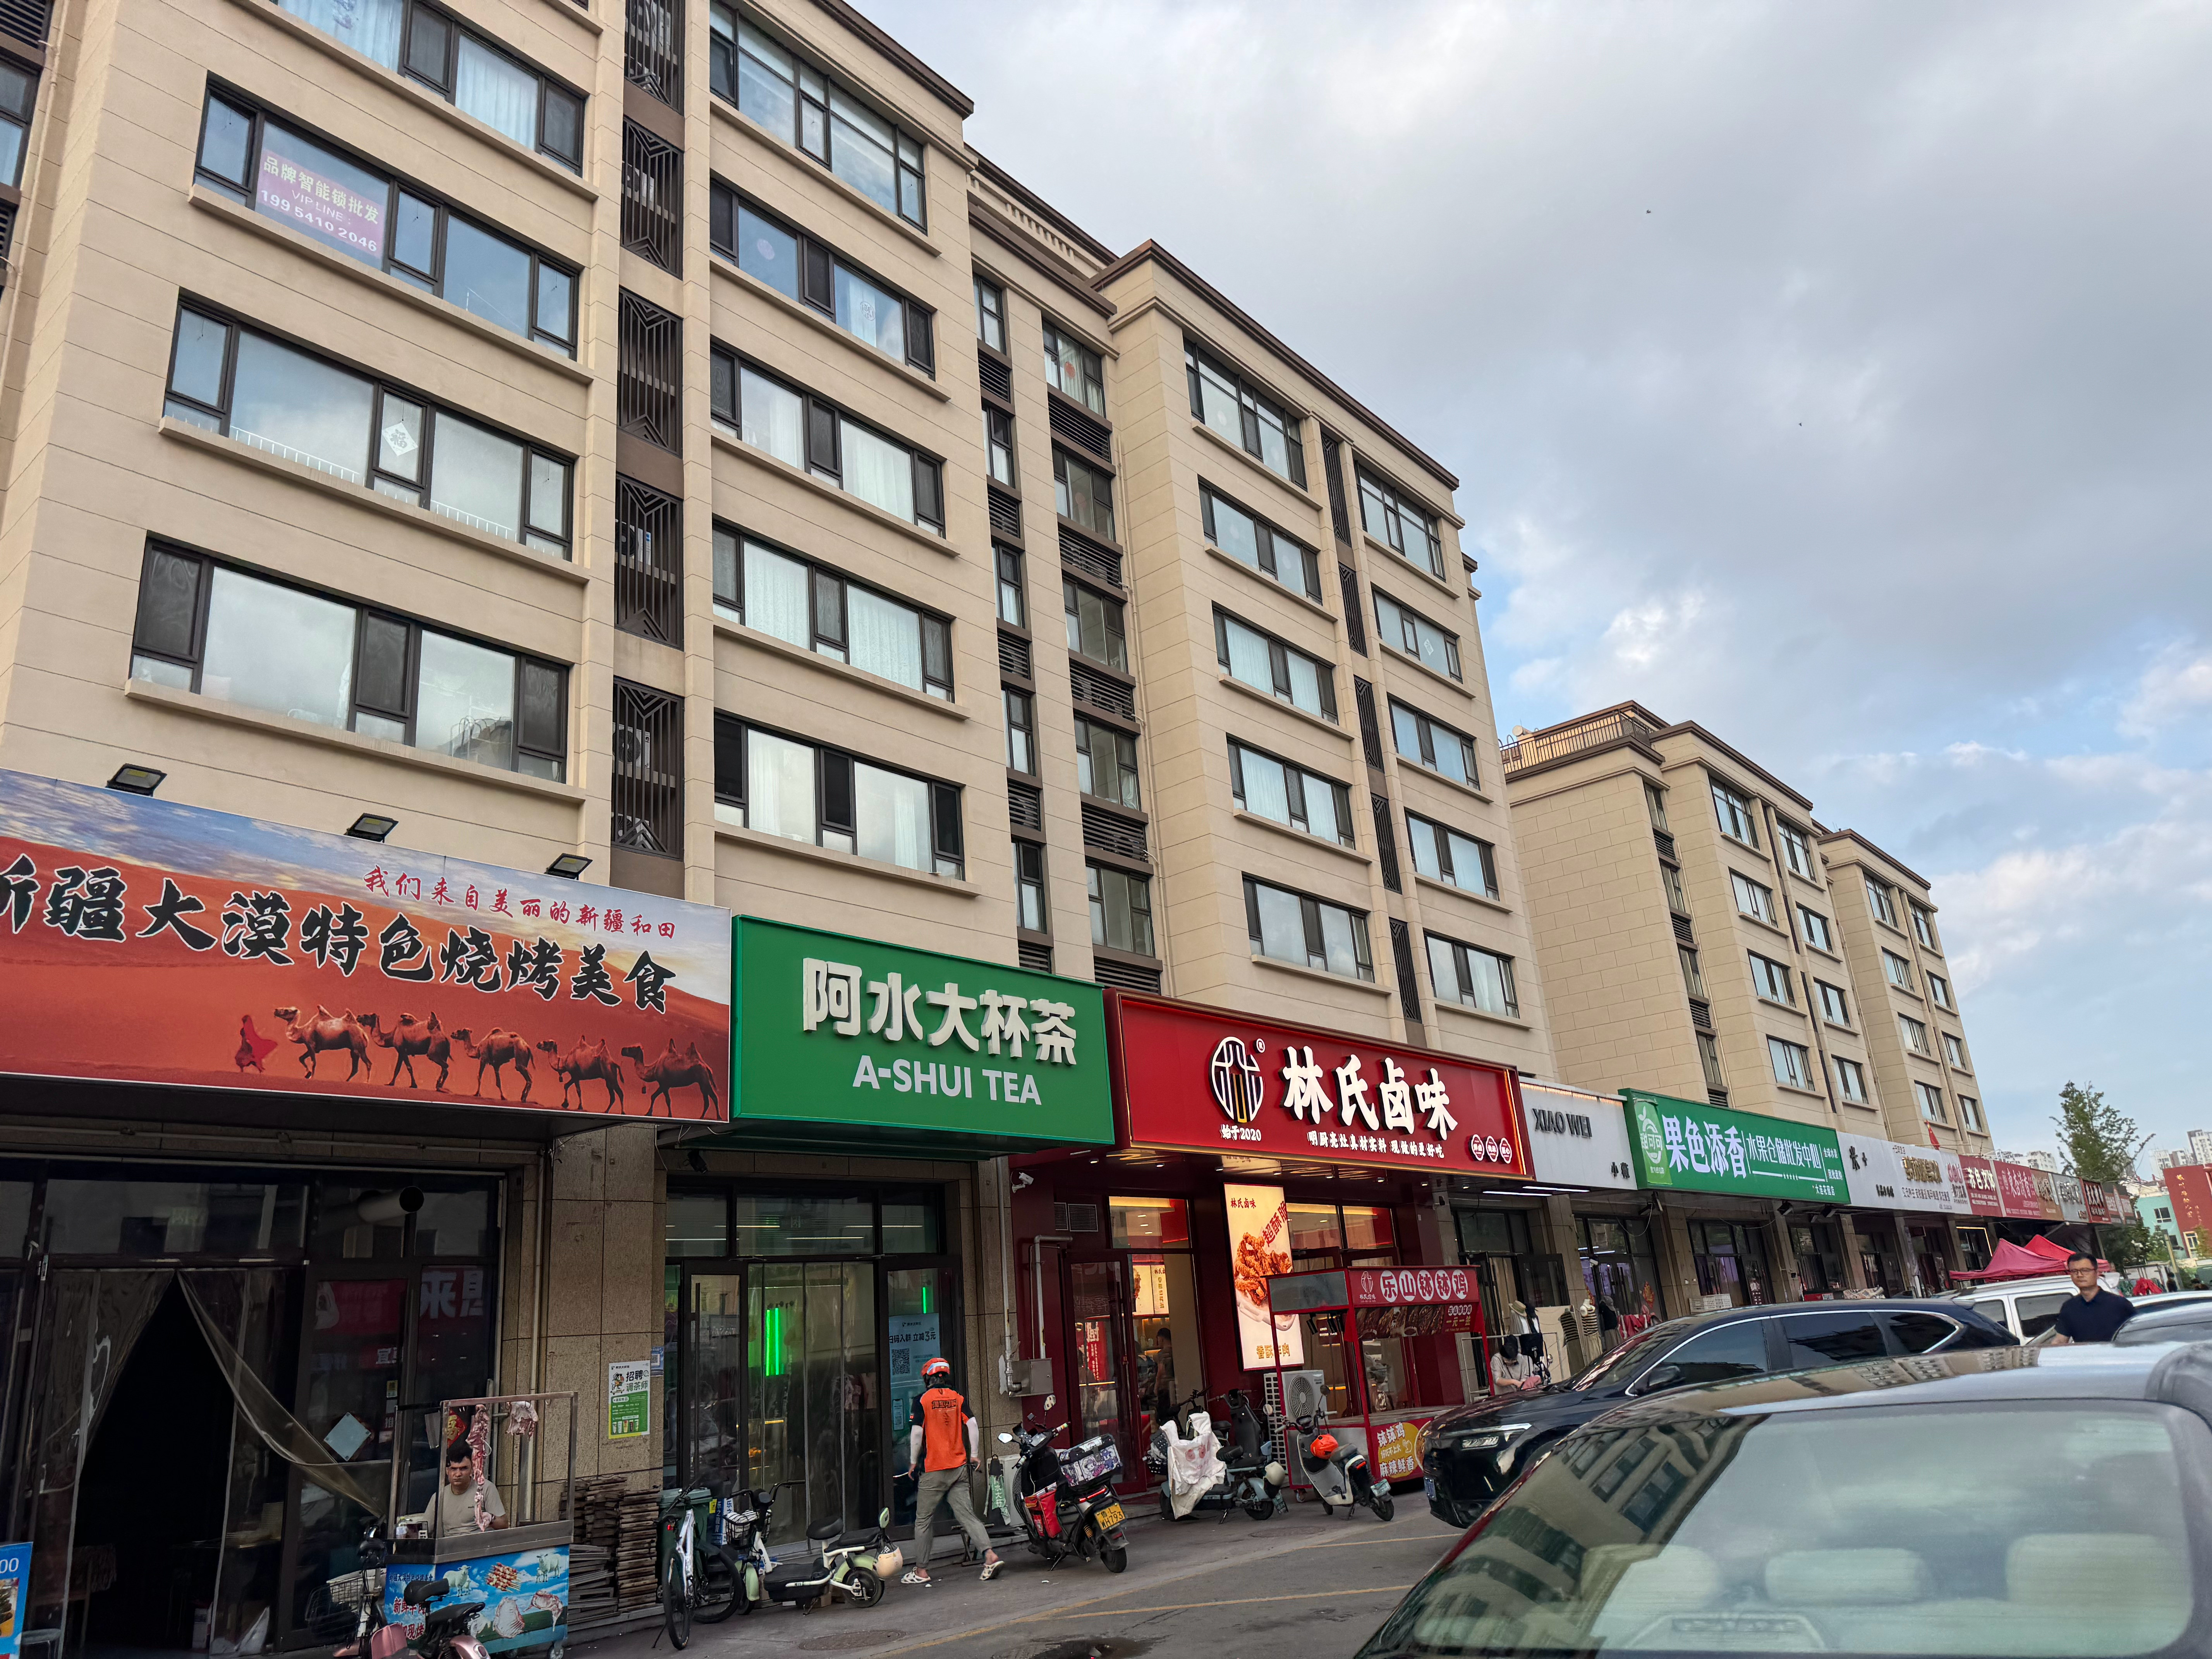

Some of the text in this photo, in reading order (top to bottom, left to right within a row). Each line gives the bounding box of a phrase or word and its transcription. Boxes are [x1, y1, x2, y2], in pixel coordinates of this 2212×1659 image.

[263, 156, 379, 224] 品牌智能锁批发
[292, 190, 313, 204] VIP
[261, 190, 377, 252] 199 5410 2046
[363, 864, 677, 940] 我们来自美丽的新疆和田
[803, 957, 1077, 1066] 阿水大杯茶
[852, 1055, 1042, 1106] A-SHUI TEA
[1280, 1044, 1458, 1141] 林氏卤味
[1220, 1123, 1262, 1142] 始于2020
[1532, 1108, 1592, 1138] XIAO WEI
[1661, 1114, 1747, 1179] 果色添香
[1747, 1132, 1822, 1169] 水果仓储批发中心
[1231, 1198, 1256, 1209] 林氏卤味
[1381, 1273, 1468, 1298] 乐山钵钵鸡
[1257, 1343, 1290, 1358] 香酥肉
[626, 1370, 643, 1382] 招聘
[627, 1381, 648, 1392] 调茶师
[1379, 1455, 1414, 1477] 麻辣鲜香
[1101, 1511, 1123, 1528] WH793
